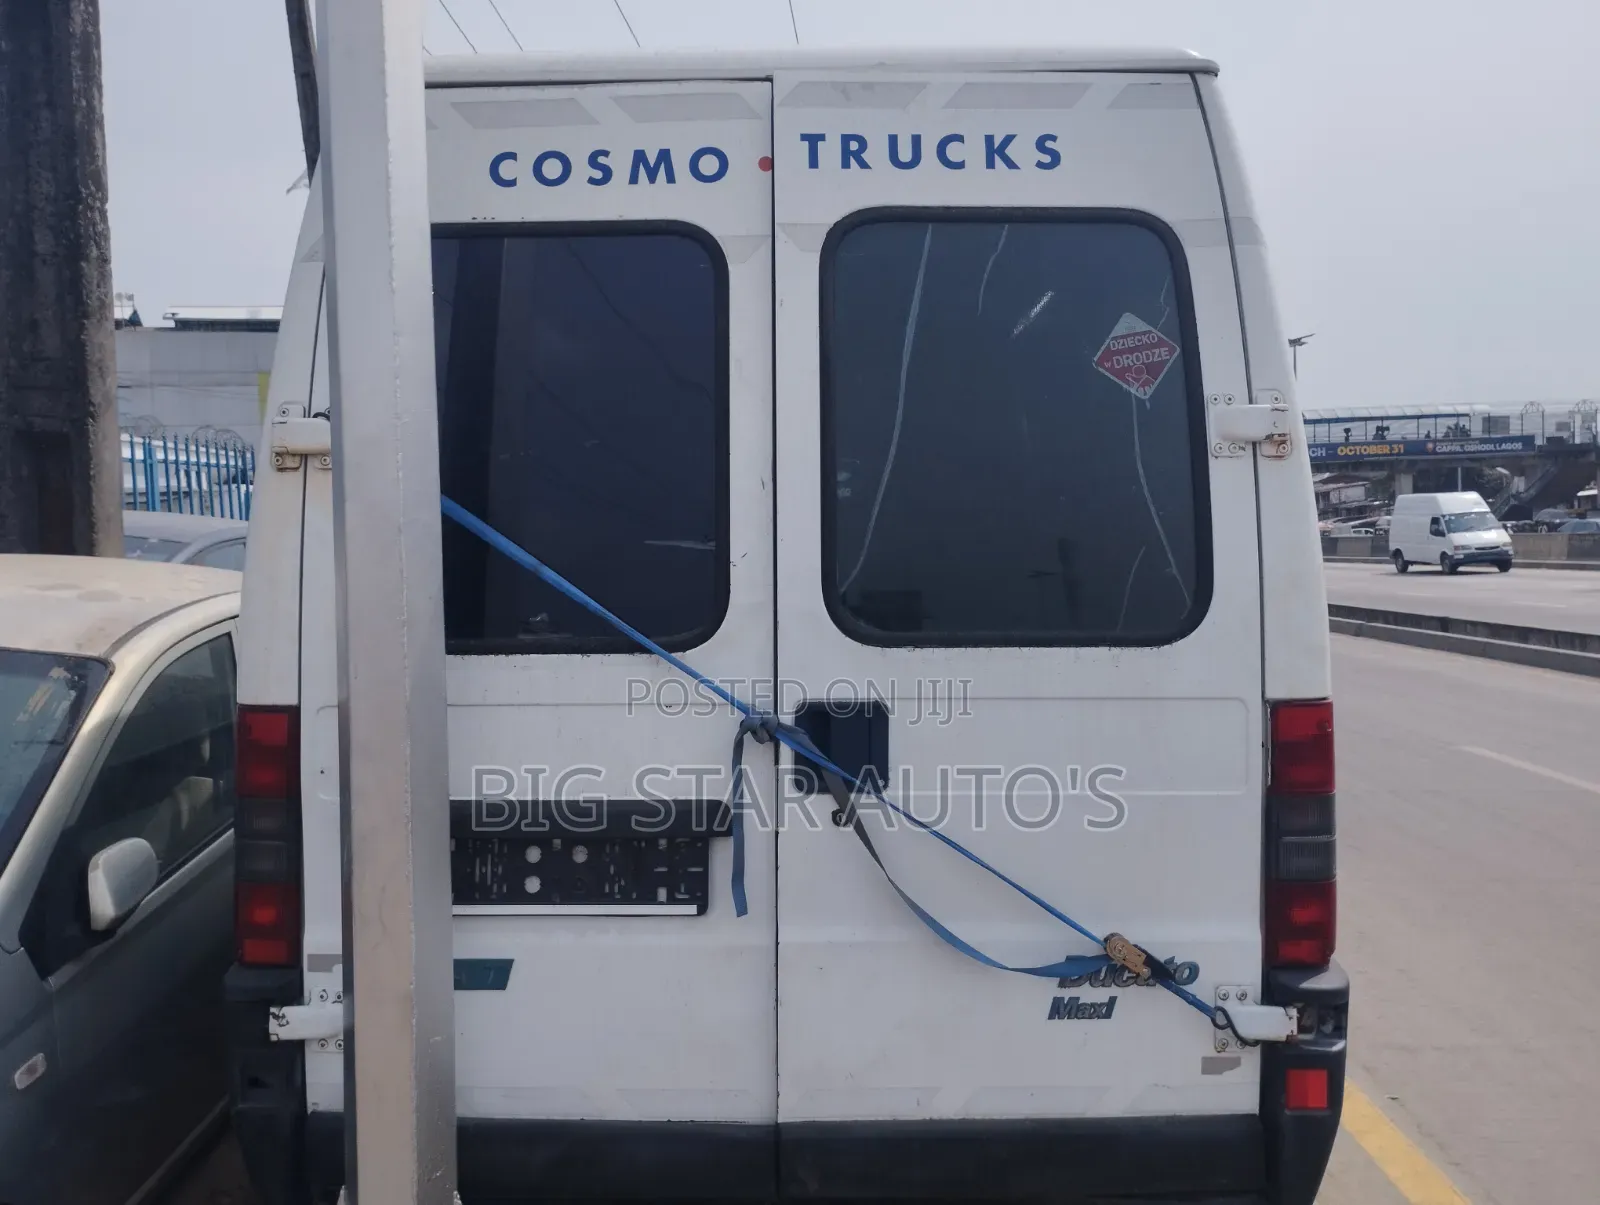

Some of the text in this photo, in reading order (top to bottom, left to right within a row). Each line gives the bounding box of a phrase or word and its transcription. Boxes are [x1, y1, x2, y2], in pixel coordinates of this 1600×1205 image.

[489, 133, 1062, 188] COSMO TRUCKS
[1110, 333, 1157, 350] DZIECKO
[1113, 347, 1170, 369] DRODZE
[1337, 445, 1391, 456] OCTOBER
[1391, 444, 1404, 454] 31
[1496, 442, 1522, 451] LAGOS
